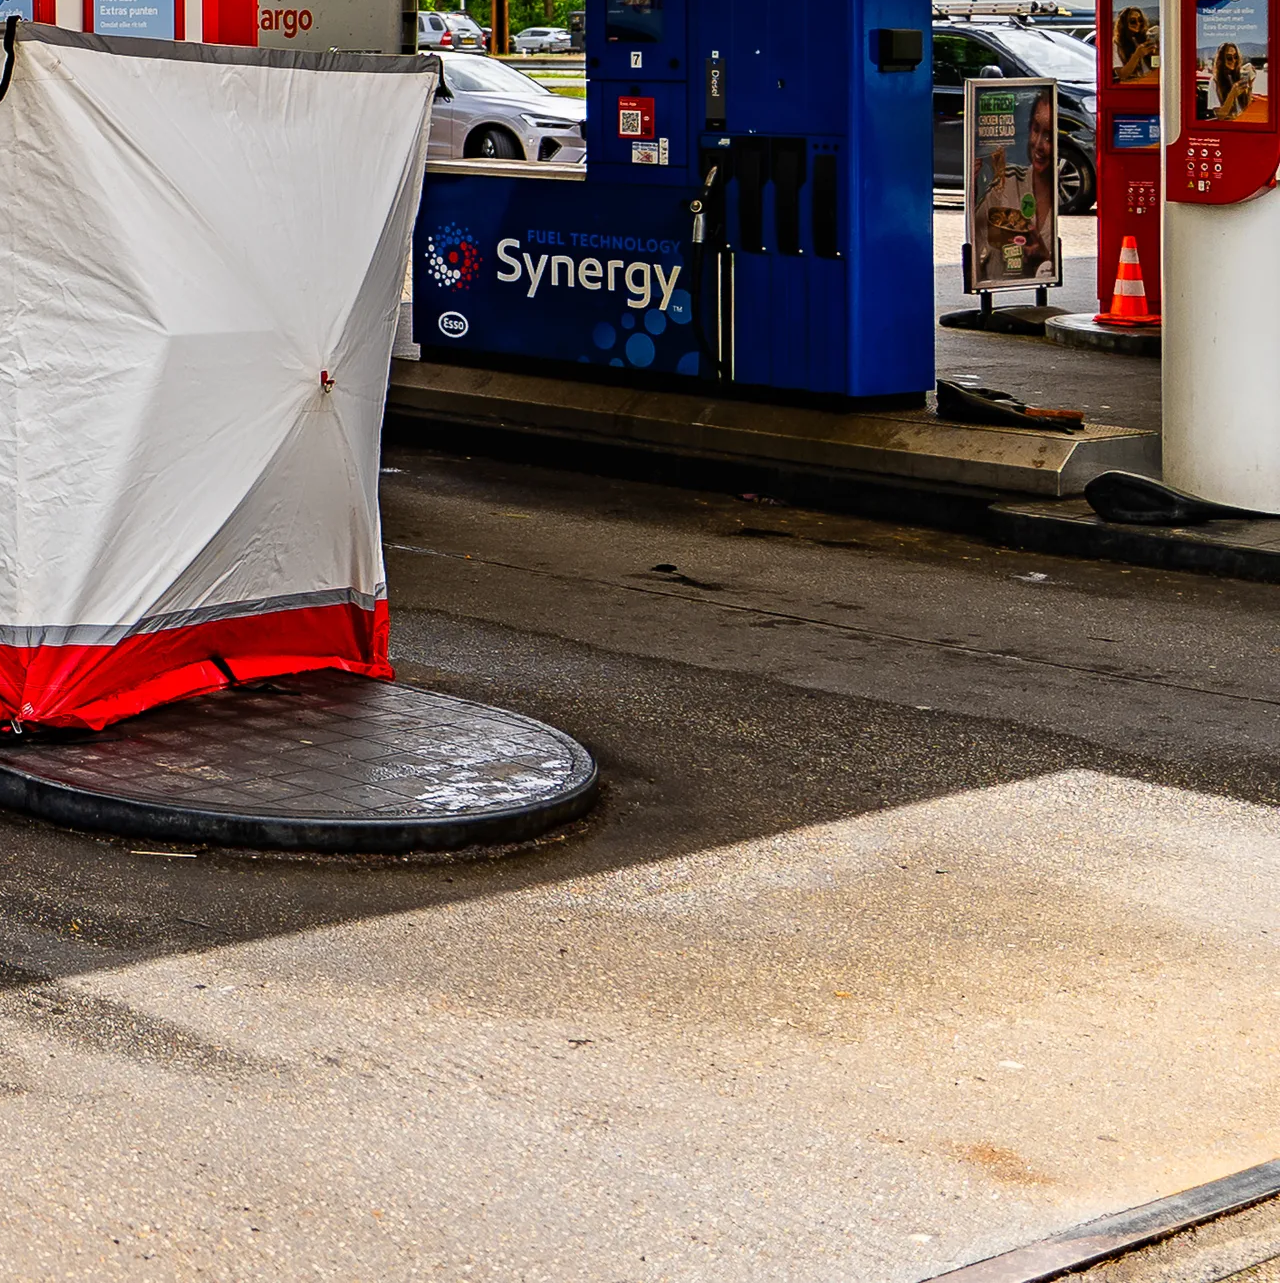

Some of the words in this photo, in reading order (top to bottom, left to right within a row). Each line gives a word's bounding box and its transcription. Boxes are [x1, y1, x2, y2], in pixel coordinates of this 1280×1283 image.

[100, 5, 128, 16] Extras
[129, 6, 158, 18] punten
[257, 5, 313, 38] argo
[632, 54, 640, 66] 7
[527, 229, 566, 246] FUEL
[570, 232, 682, 254] TECHNOLOGY
[496, 238, 682, 311] Synergy
[443, 318, 464, 330] Esso
